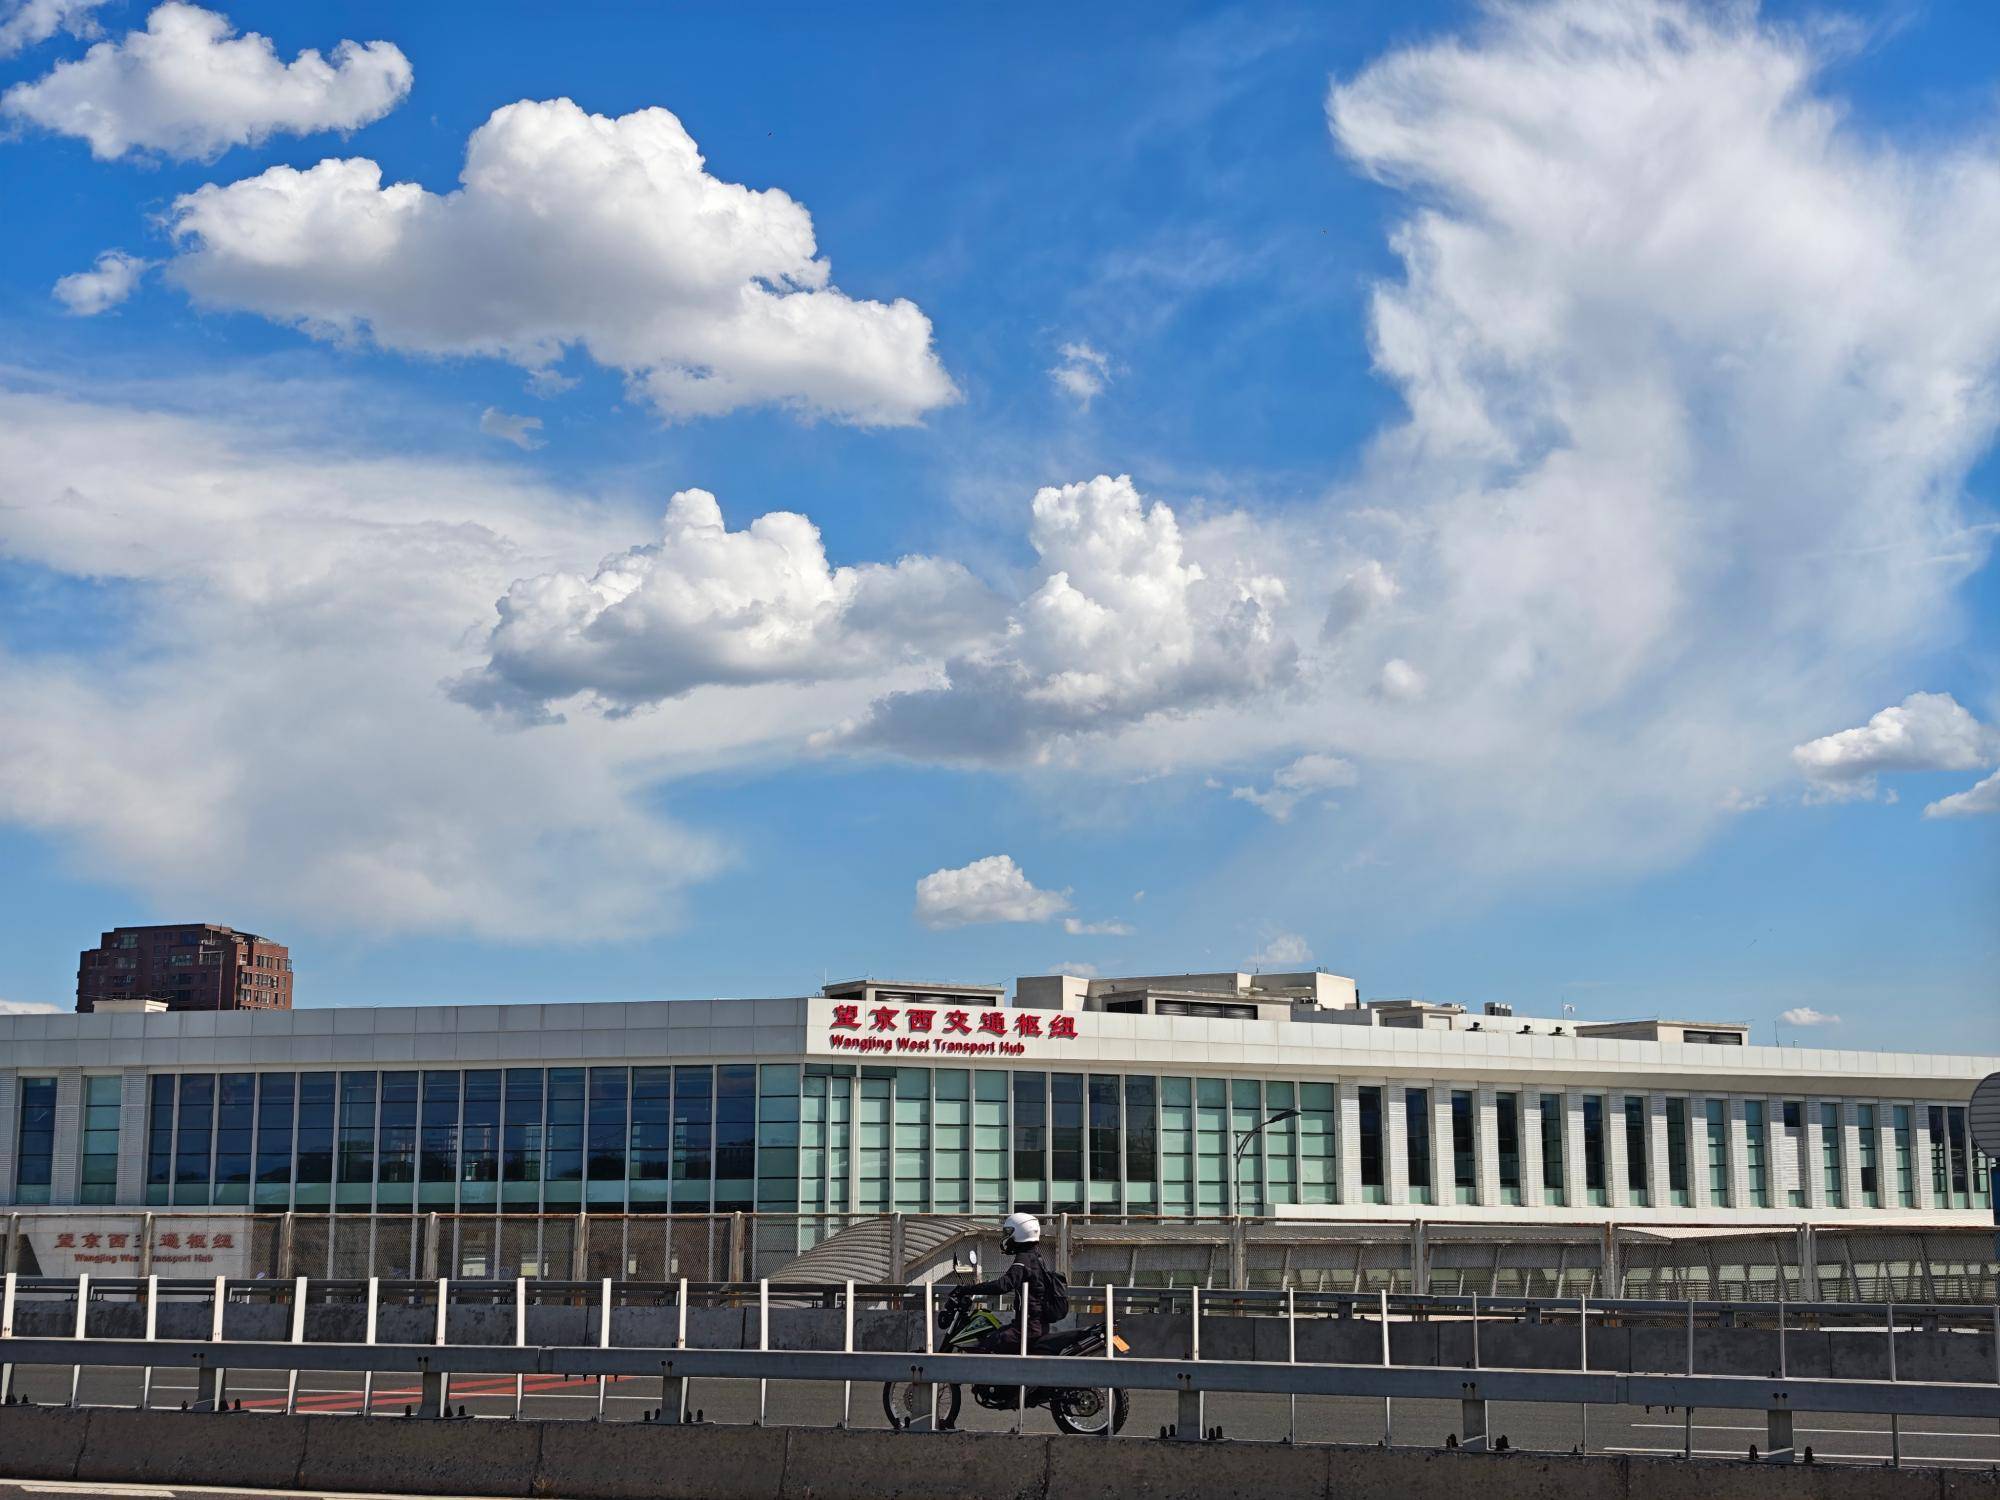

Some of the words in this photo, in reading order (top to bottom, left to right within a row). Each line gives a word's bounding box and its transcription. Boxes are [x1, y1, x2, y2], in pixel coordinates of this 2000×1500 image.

[830, 1004, 1078, 1039] 望京西交通枢纽
[830, 1034, 893, 1054] Wangjing
[896, 1037, 930, 1053] West
[933, 1039, 996, 1056] Transport
[999, 1041, 1025, 1056] Hub
[74, 1253, 118, 1264] Wangjing
[120, 1253, 141, 1263] Wes
[151, 1255, 192, 1264] ransport
[194, 1254, 214, 1263] Hub
